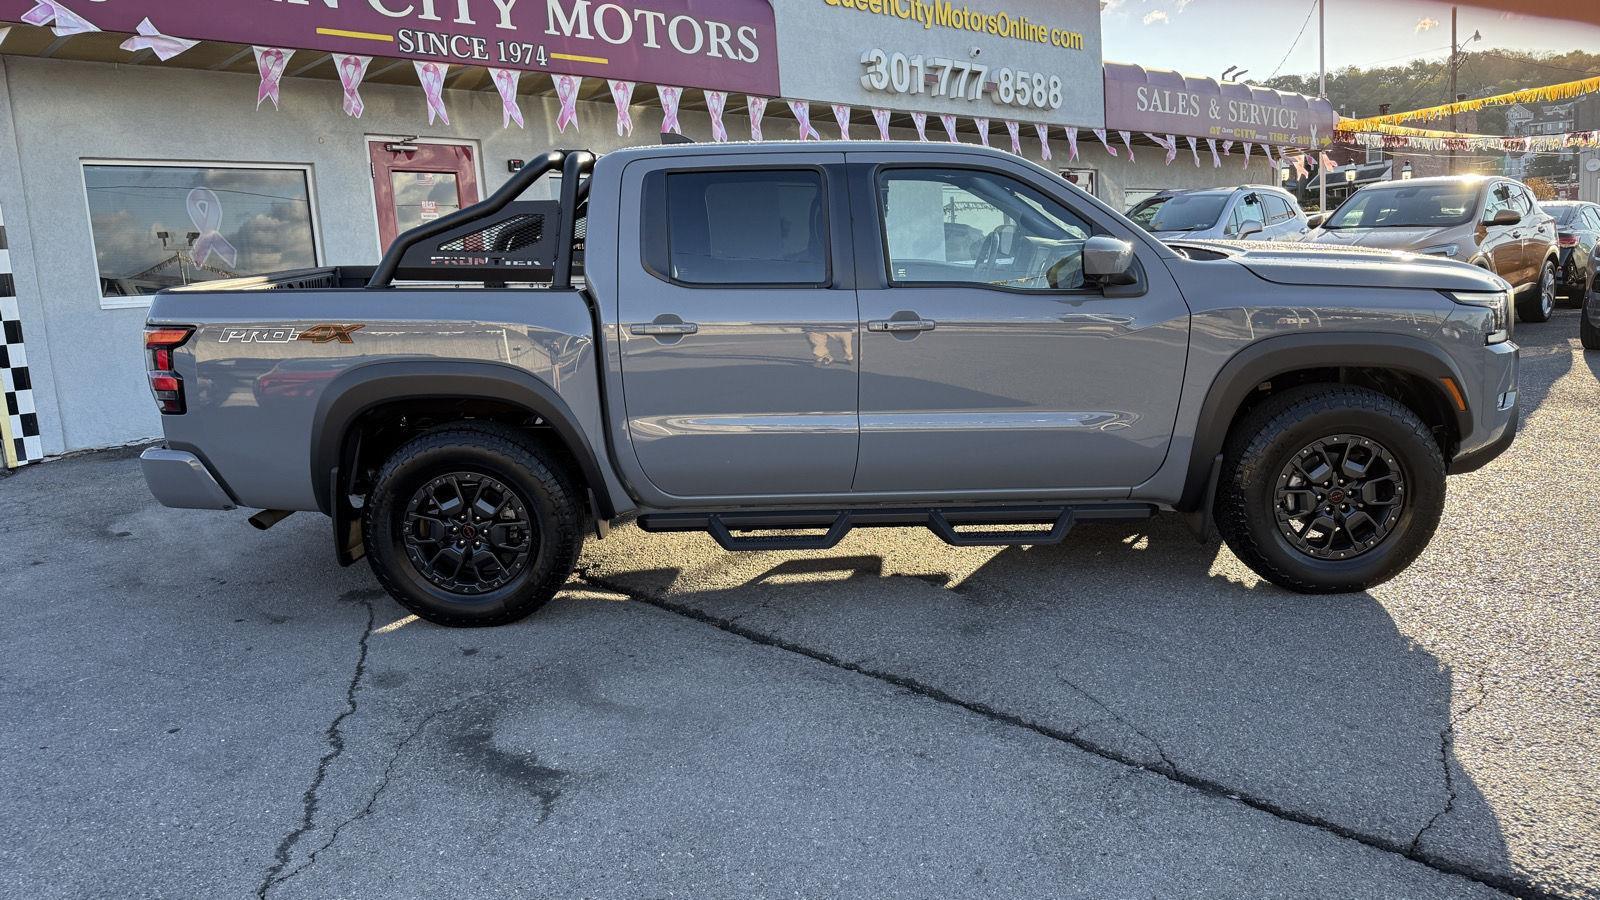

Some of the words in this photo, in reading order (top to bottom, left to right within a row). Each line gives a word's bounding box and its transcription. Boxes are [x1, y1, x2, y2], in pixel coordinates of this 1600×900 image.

[544, 0, 760, 63] MOTORS
[825, 0, 1047, 43] eenCityMotorsOnline
[398, 29, 489, 61] SINCE
[498, 41, 548, 66] 1974
[1136, 86, 1200, 117] SALES
[1208, 97, 1221, 120] &
[1228, 100, 1298, 130] SERVICE
[430, 256, 542, 266] FRONTIER
